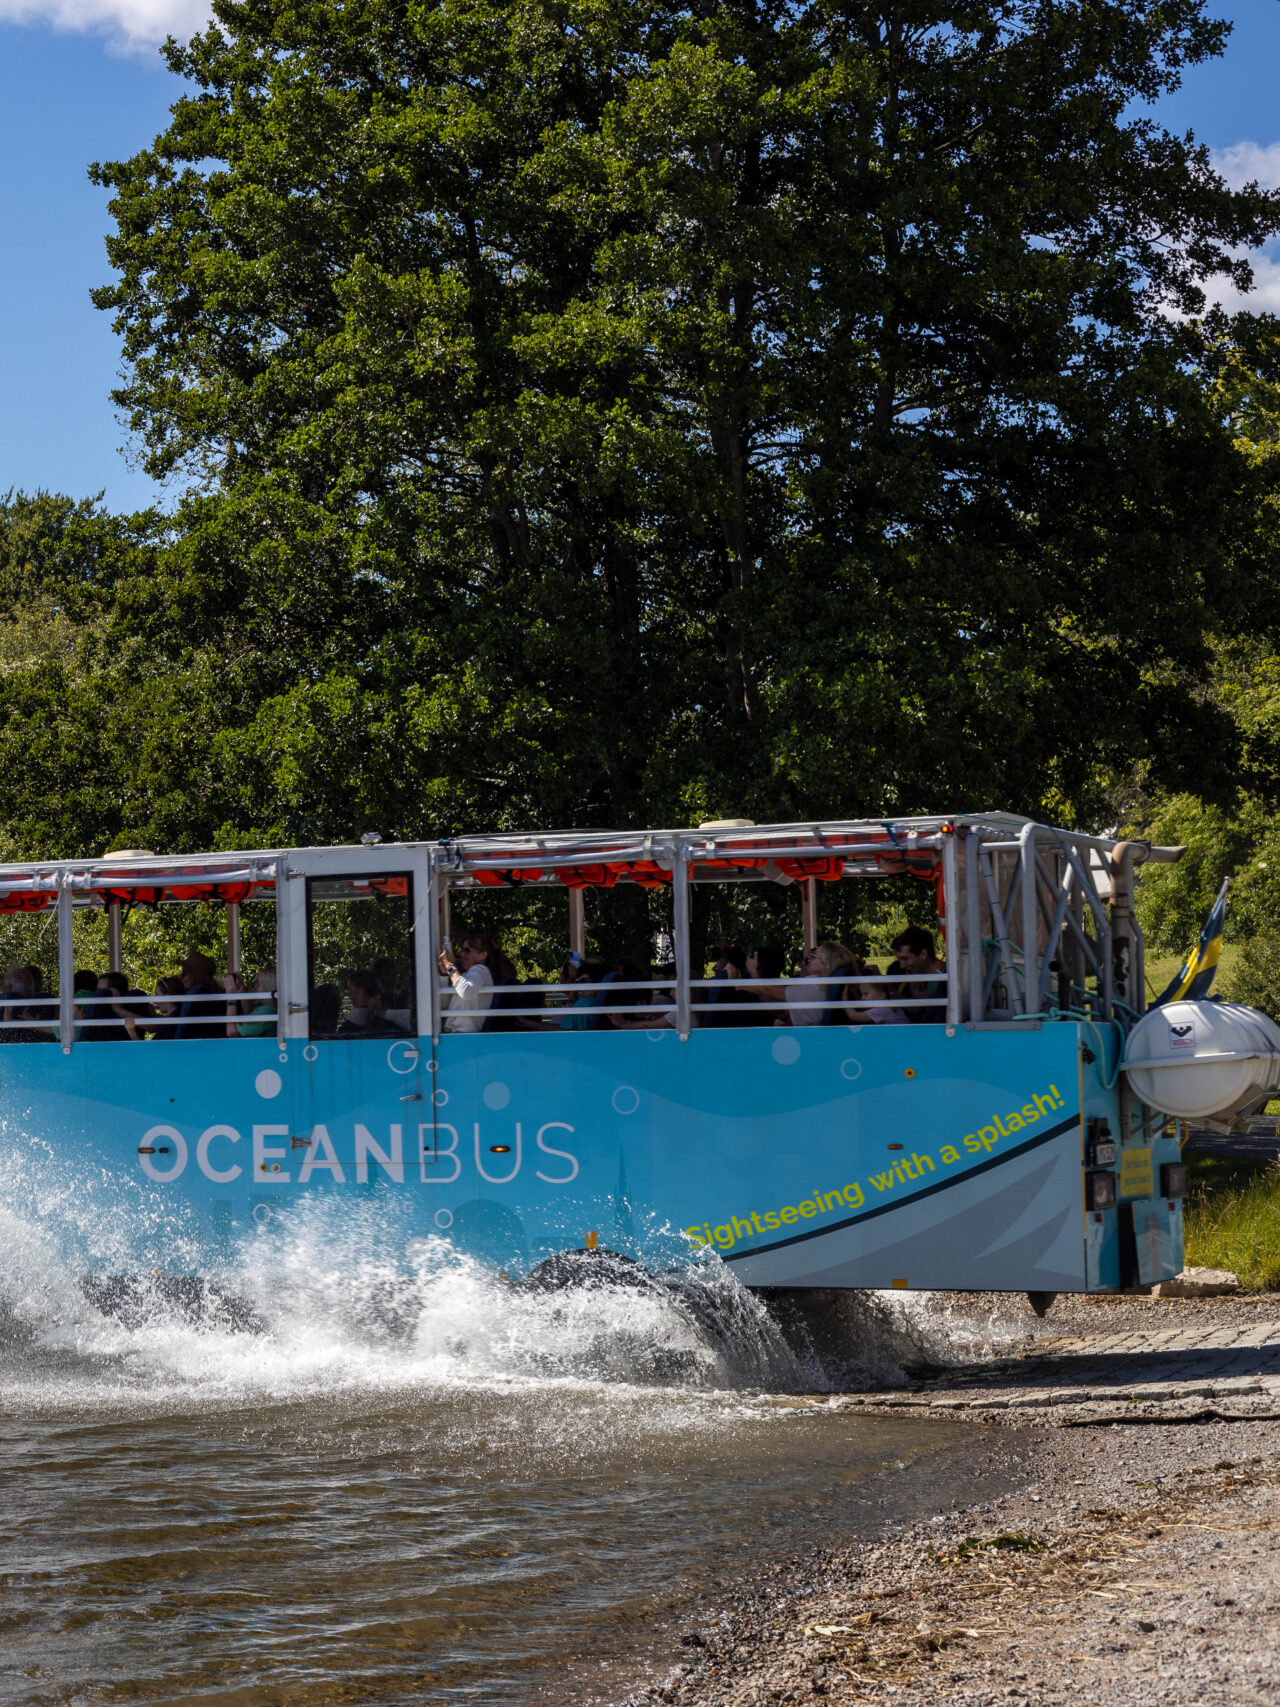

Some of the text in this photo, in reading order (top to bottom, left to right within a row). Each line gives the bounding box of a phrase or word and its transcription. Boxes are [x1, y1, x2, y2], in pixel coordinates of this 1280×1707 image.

[138, 1122, 579, 1184] OCEANBUS
[686, 1084, 1065, 1249] Sightseeing with a splash!
